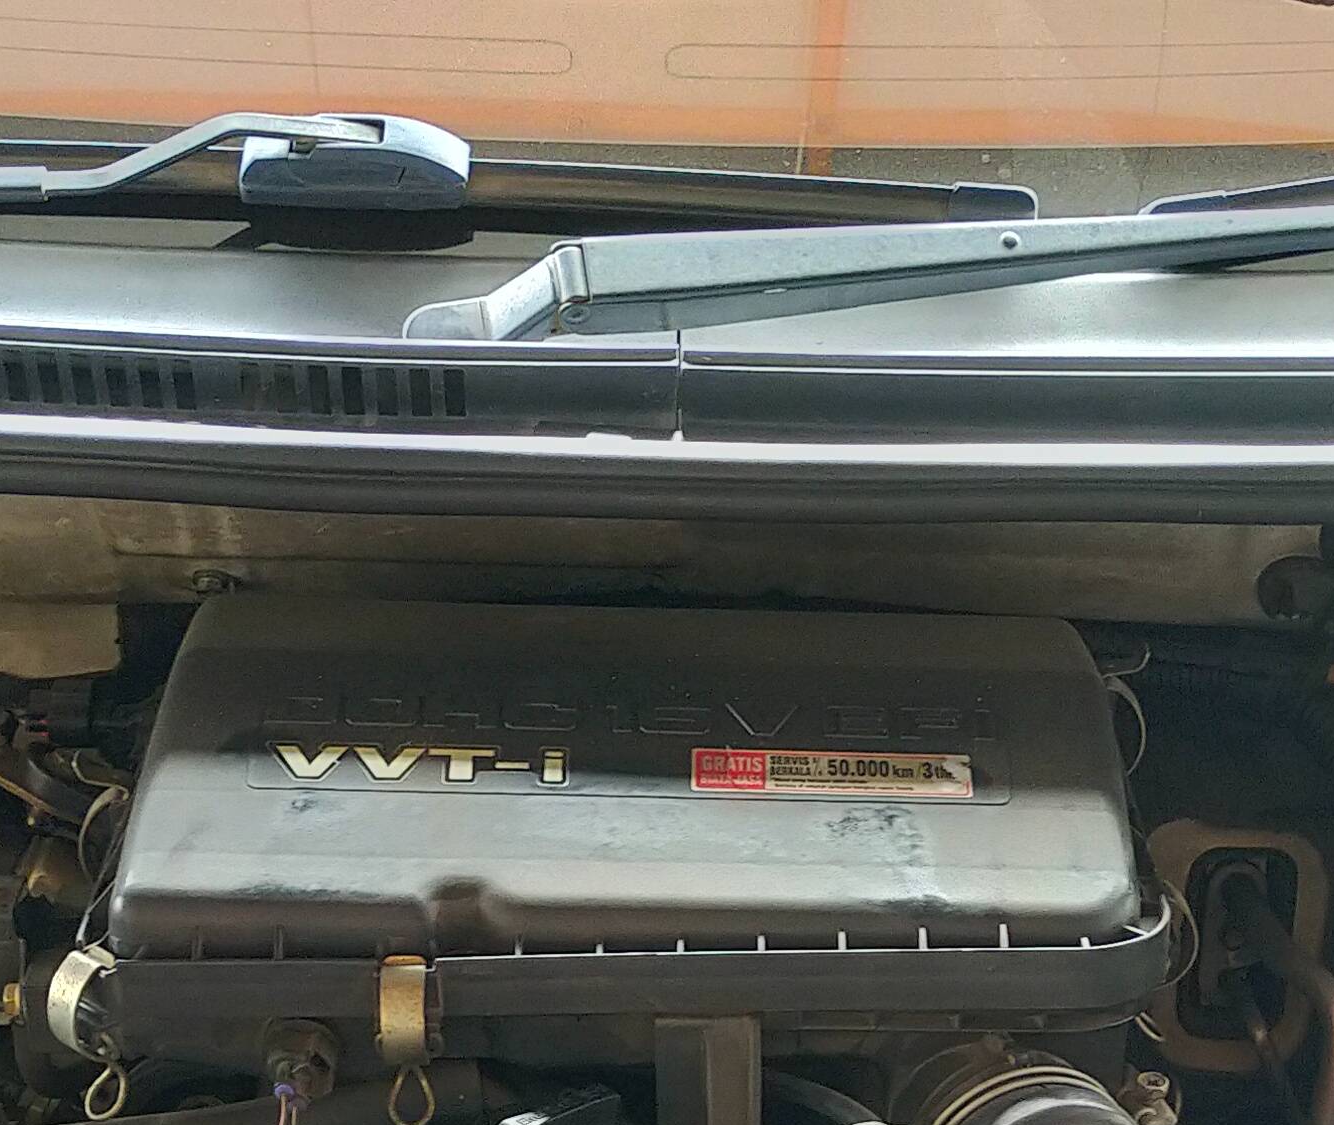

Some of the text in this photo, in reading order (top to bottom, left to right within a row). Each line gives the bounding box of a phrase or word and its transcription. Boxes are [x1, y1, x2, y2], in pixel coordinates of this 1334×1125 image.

[264, 696, 577, 731] DOHC
[605, 702, 800, 738] 16V
[271, 742, 568, 786] VVT-i
[702, 755, 764, 772] GRATIS
[770, 756, 809, 766] SERVIS
[828, 759, 890, 778] 50.000
[892, 765, 914, 779] km
